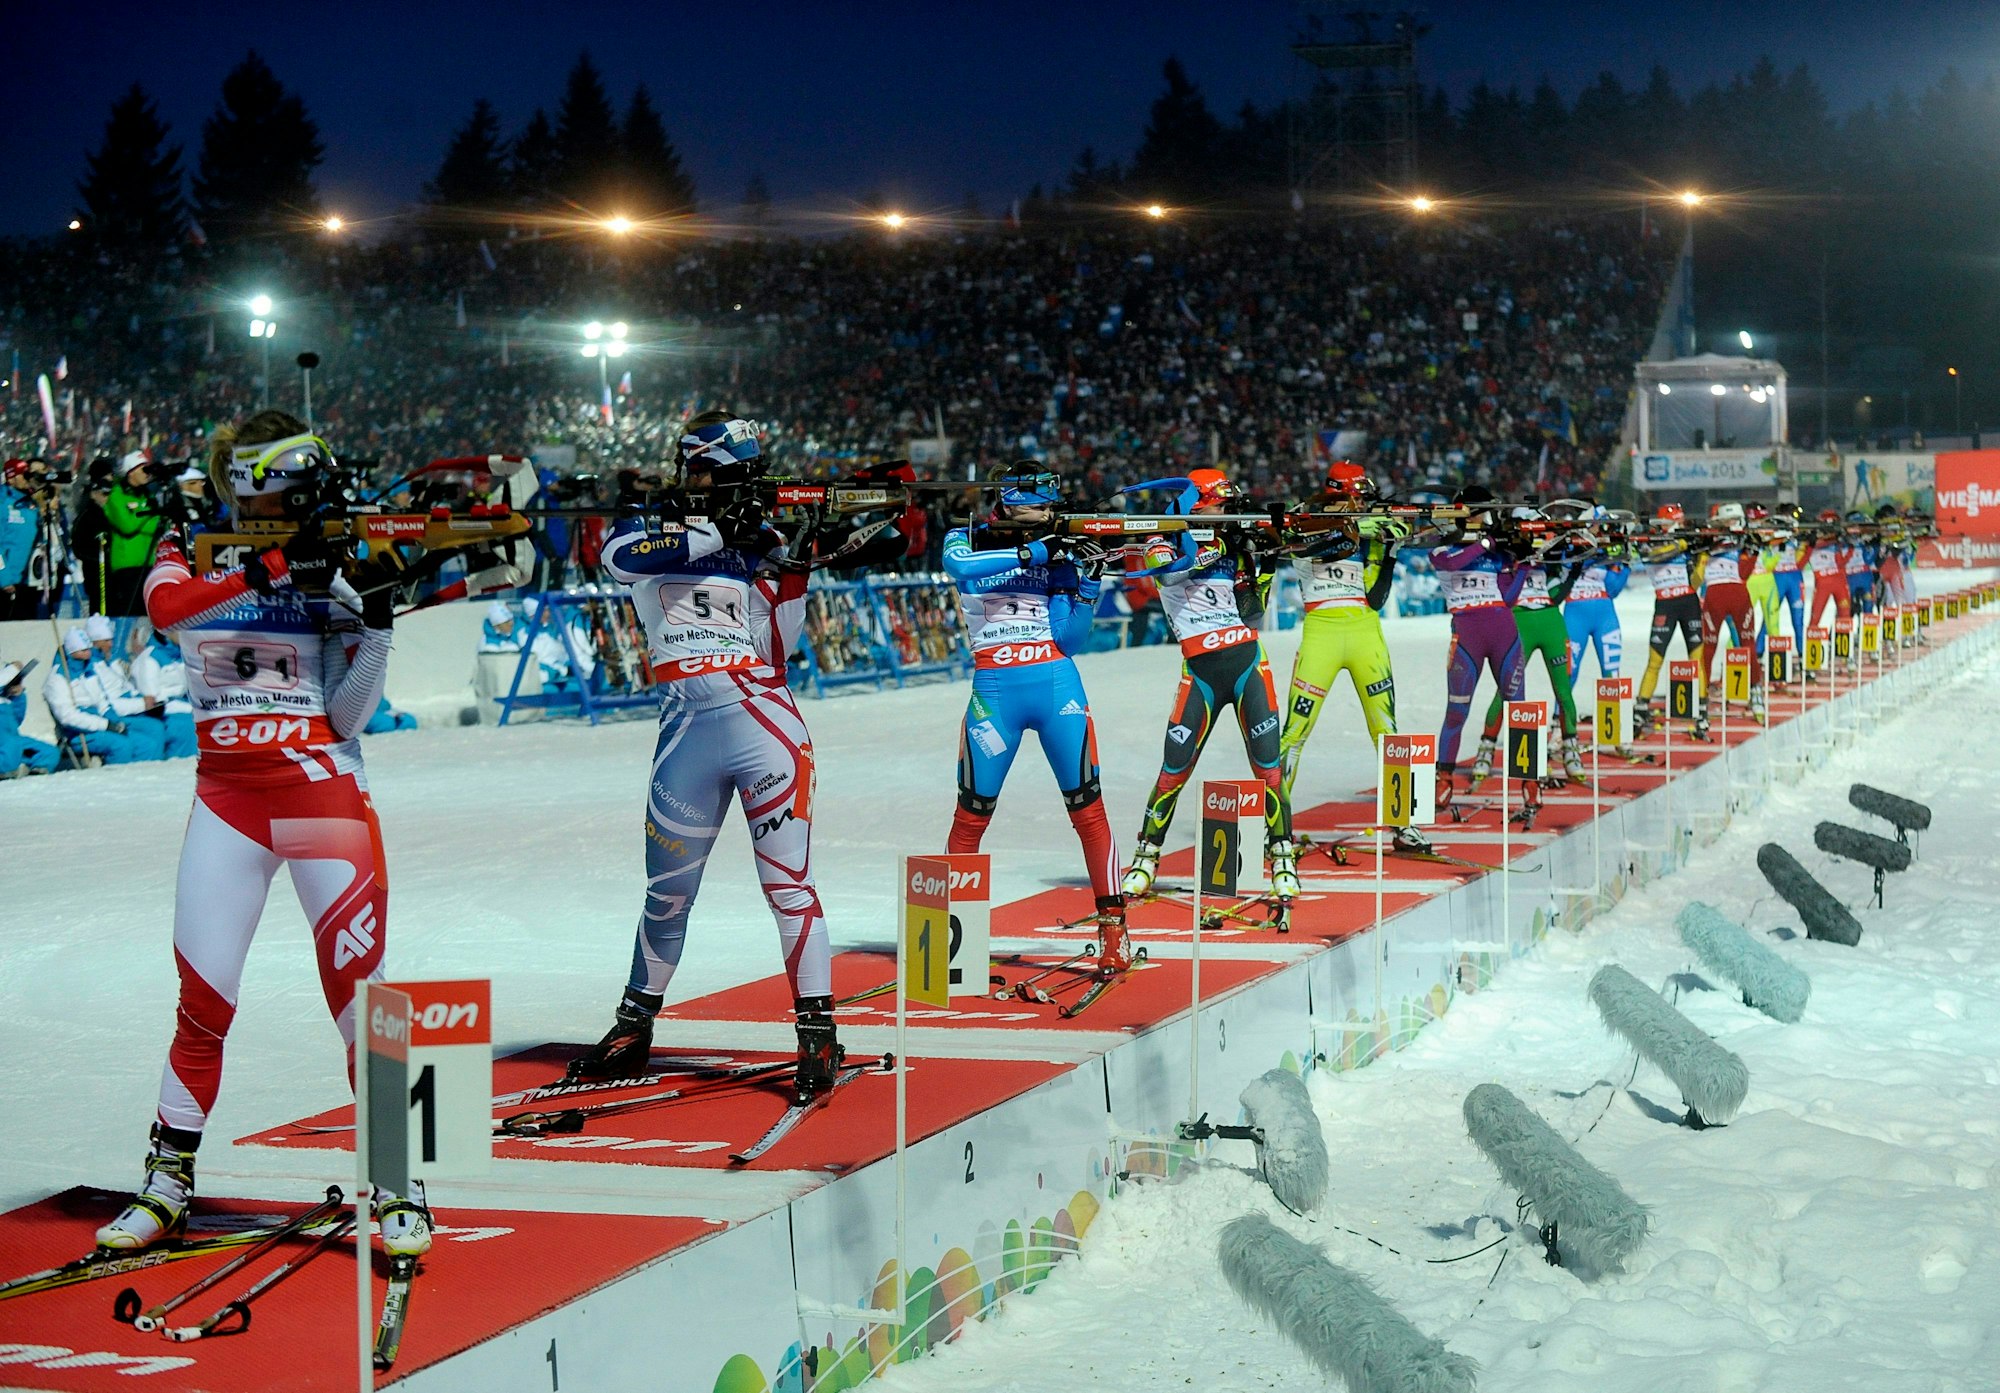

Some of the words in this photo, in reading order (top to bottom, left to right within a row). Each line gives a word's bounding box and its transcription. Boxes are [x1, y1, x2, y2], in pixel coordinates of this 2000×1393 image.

[778, 489, 824, 502] VIESSMANN
[839, 490, 885, 501] somfy
[369, 519, 425, 536] VIESSMANN
[1084, 522, 1121, 532] VIESSMANN
[630, 535, 680, 556] somfy
[289, 558, 327, 571] Roeckl
[1325, 566, 1343, 579] 10
[692, 590, 711, 620] 5
[725, 601, 739, 622] 1
[1206, 589, 1217, 606] 9
[664, 631, 687, 646] Nove
[688, 628, 716, 642] Mesto
[983, 629, 998, 640] Nove
[1000, 625, 1020, 635] Mesto
[1864, 629, 1874, 648] 11
[1883, 620, 1896, 640] 12
[1810, 644, 1817, 666] 9
[1836, 634, 1849, 656] 10
[234, 648, 259, 681] 6
[275, 657, 290, 682] 1
[1772, 653, 1782, 680] 8
[1733, 671, 1742, 697] 7
[220, 693, 253, 708] Mesto
[272, 693, 312, 706] Morave
[1676, 683, 1687, 715] 6
[1251, 714, 1277, 738] ATEX
[1604, 707, 1614, 740] 5
[1516, 734, 1530, 774] 4
[753, 772, 776, 790] CAISSE
[1391, 772, 1401, 818] 3
[648, 822, 689, 858] omfy
[1211, 828, 1228, 887] 2
[918, 918, 931, 992] 1
[1218, 1018, 1227, 1052] 3
[536, 1076, 662, 1099] MADSHUS
[410, 1064, 437, 1163] 1
[964, 1141, 975, 1184] 2
[87, 1249, 171, 1280] FISCHER
[545, 1338, 559, 1391] 1
